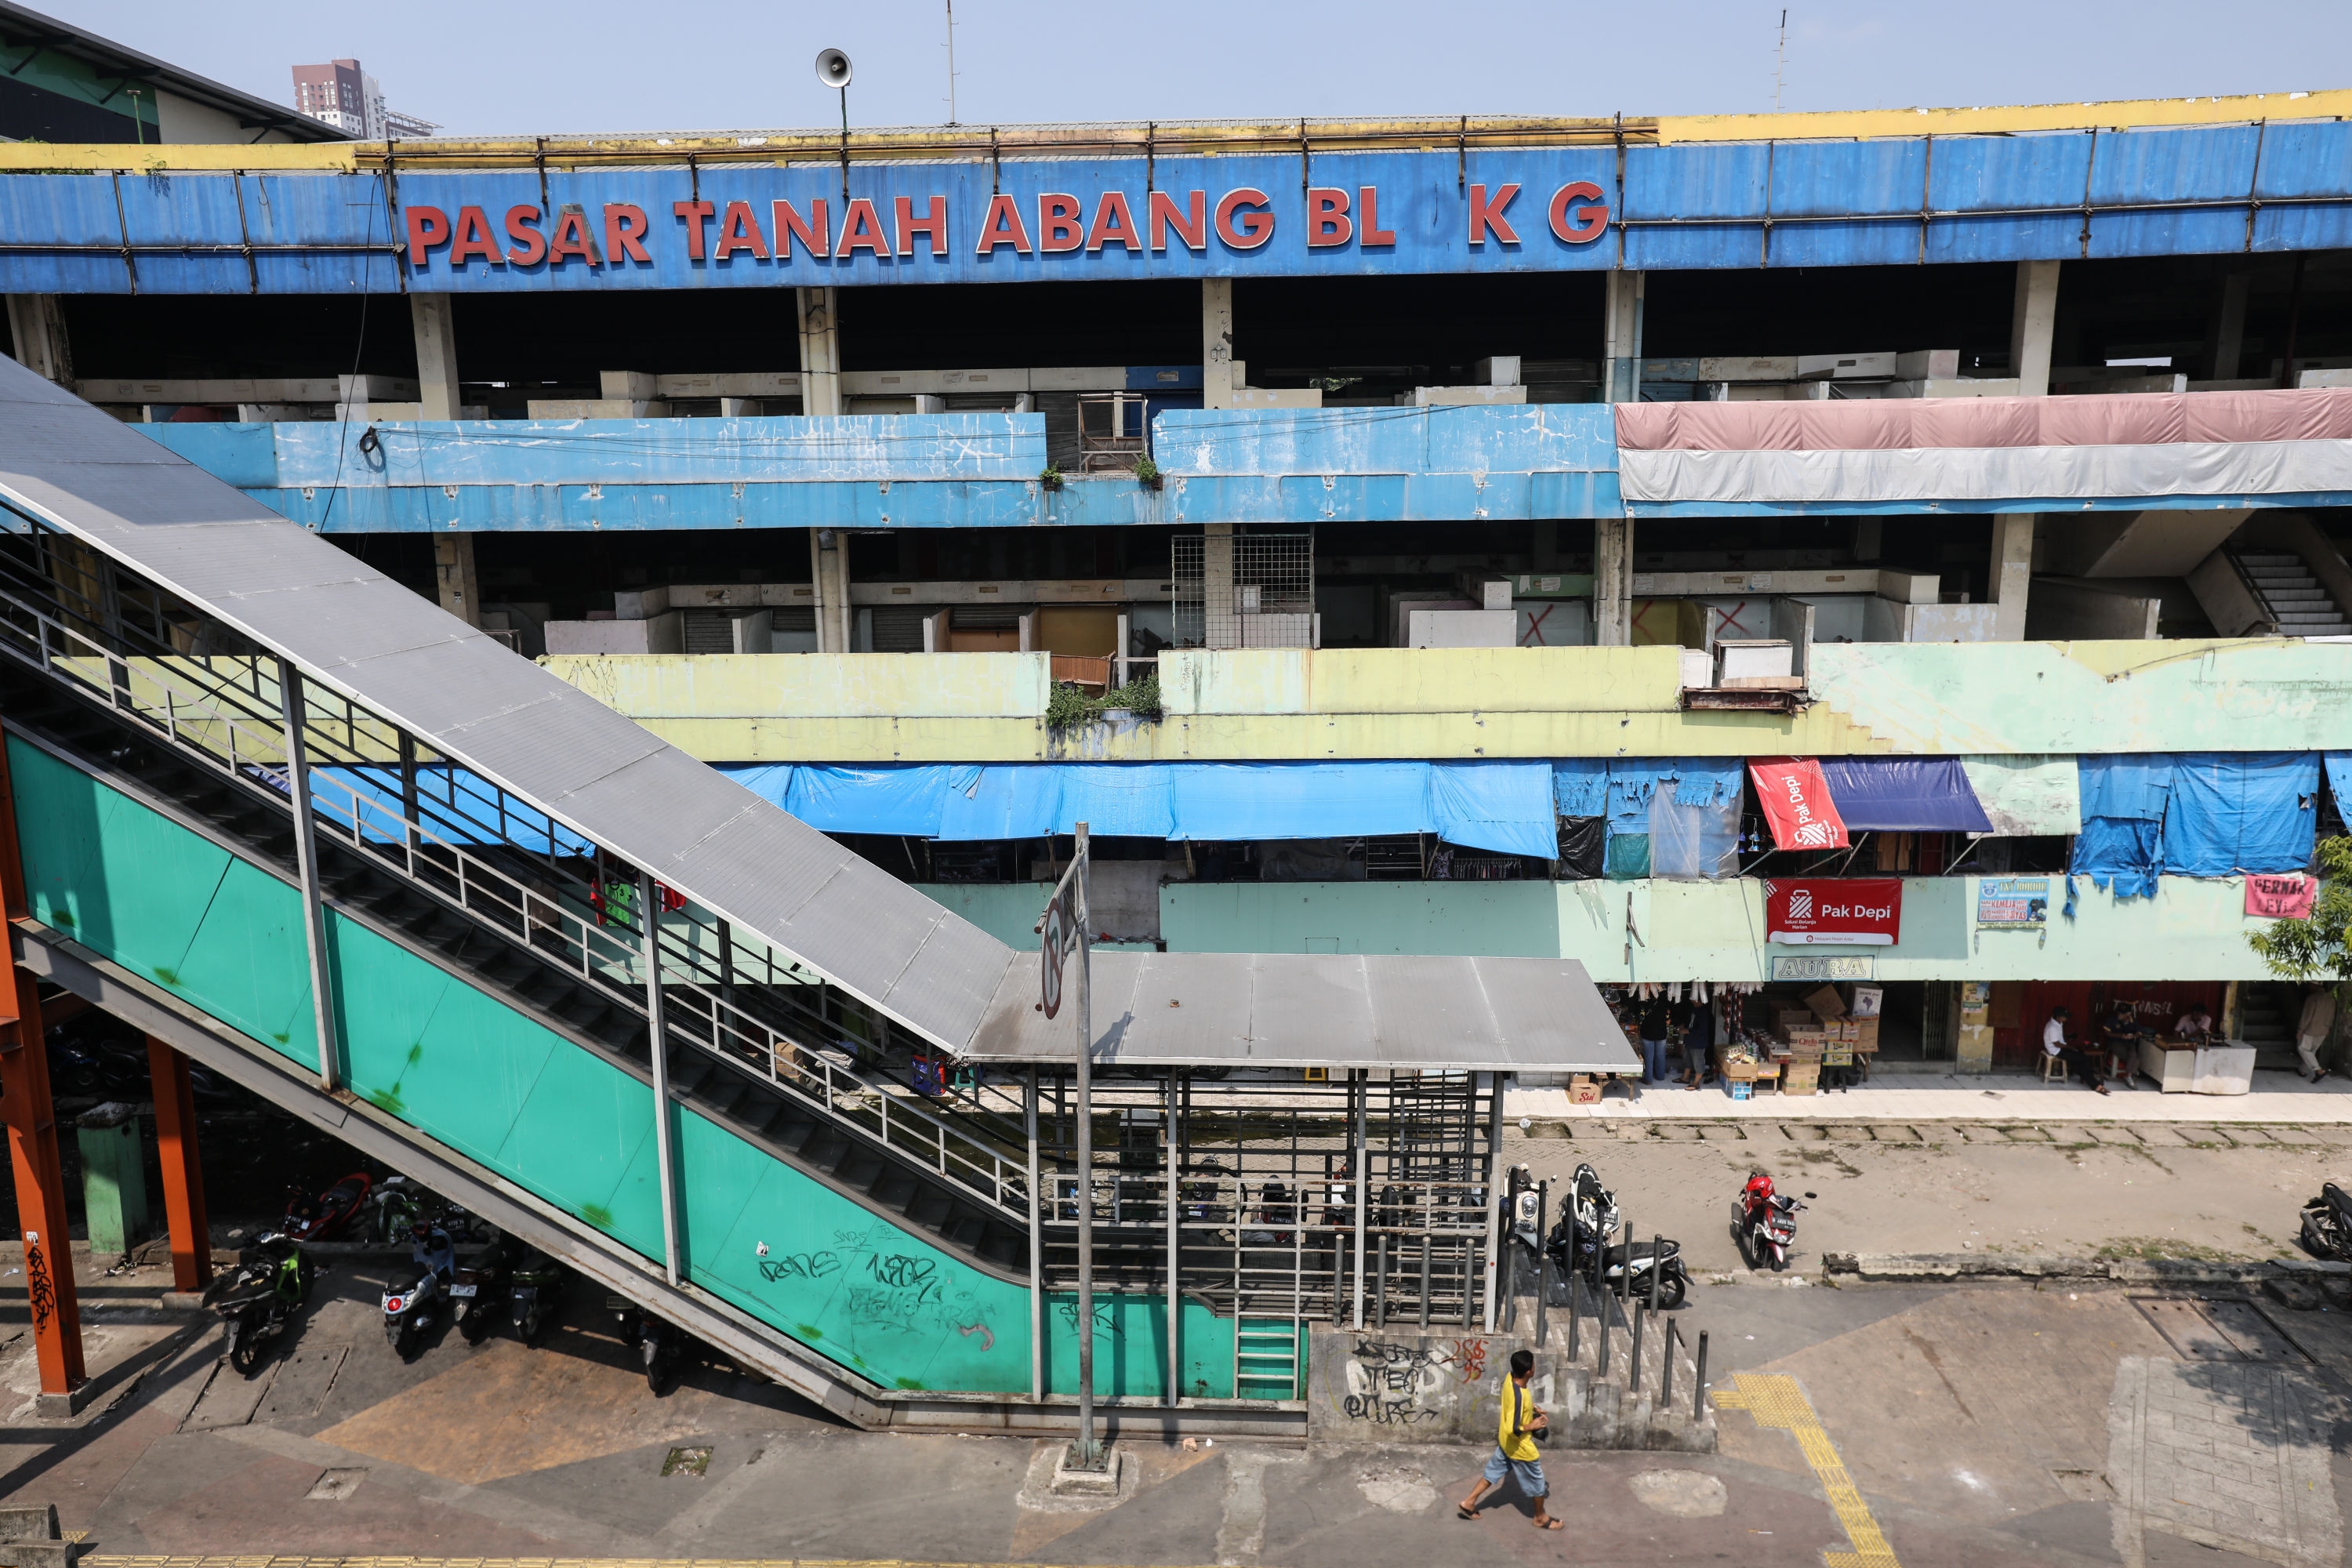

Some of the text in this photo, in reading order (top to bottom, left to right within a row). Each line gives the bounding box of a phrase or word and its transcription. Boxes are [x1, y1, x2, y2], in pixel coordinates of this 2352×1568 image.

[405, 204, 653, 267] PASAR
[673, 196, 948, 260] TANAH
[976, 187, 1275, 255] ABANG
[1548, 181, 1610, 244] G
[1780, 775, 1813, 824] Pak Depi
[1821, 905, 1891, 921] Pak Depi
[1991, 900, 2016, 909] KEMEJA
[1779, 958, 1867, 978] AURA
